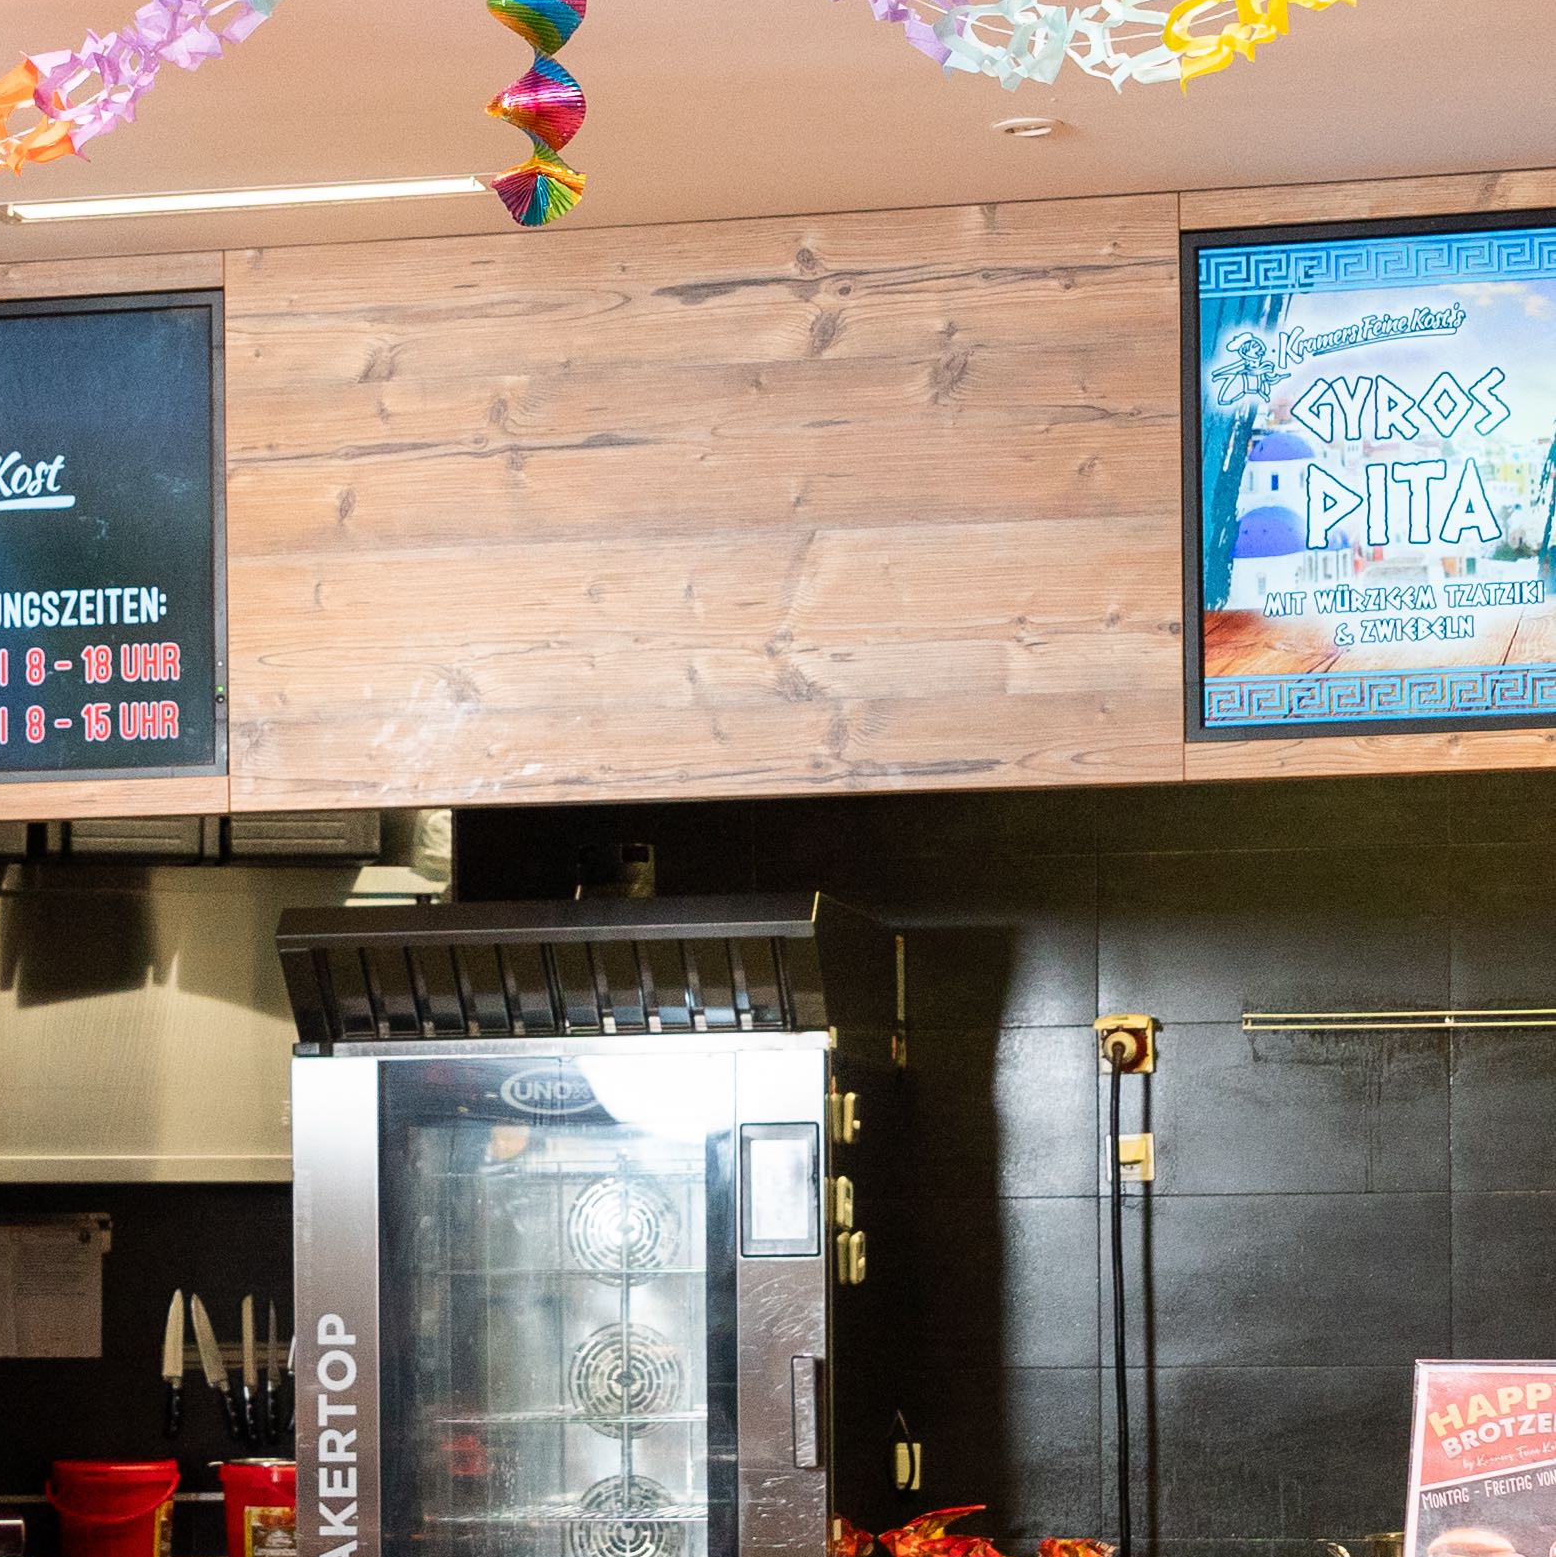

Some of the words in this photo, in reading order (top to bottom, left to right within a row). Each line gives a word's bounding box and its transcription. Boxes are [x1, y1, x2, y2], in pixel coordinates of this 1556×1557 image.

[1278, 326, 1358, 369] Kramers
[1361, 314, 1409, 338] Feine
[1291, 367, 1510, 443] GYROS
[1306, 457, 1502, 549] PITA
[1263, 592, 1306, 617] MIT
[1314, 584, 1437, 614] WÜRZIGEM
[1444, 580, 1545, 608] TZATZIKI
[1334, 623, 1354, 646] &
[1360, 615, 1475, 643] ZWIEBELN
[26, 647, 45, 686] 8
[81, 645, 112, 684] 18
[121, 642, 180, 681] UHR
[26, 705, 45, 744] 8
[81, 703, 111, 741] 15
[119, 701, 179, 740] UHR
[1427, 1382, 1556, 1438] HAPP
